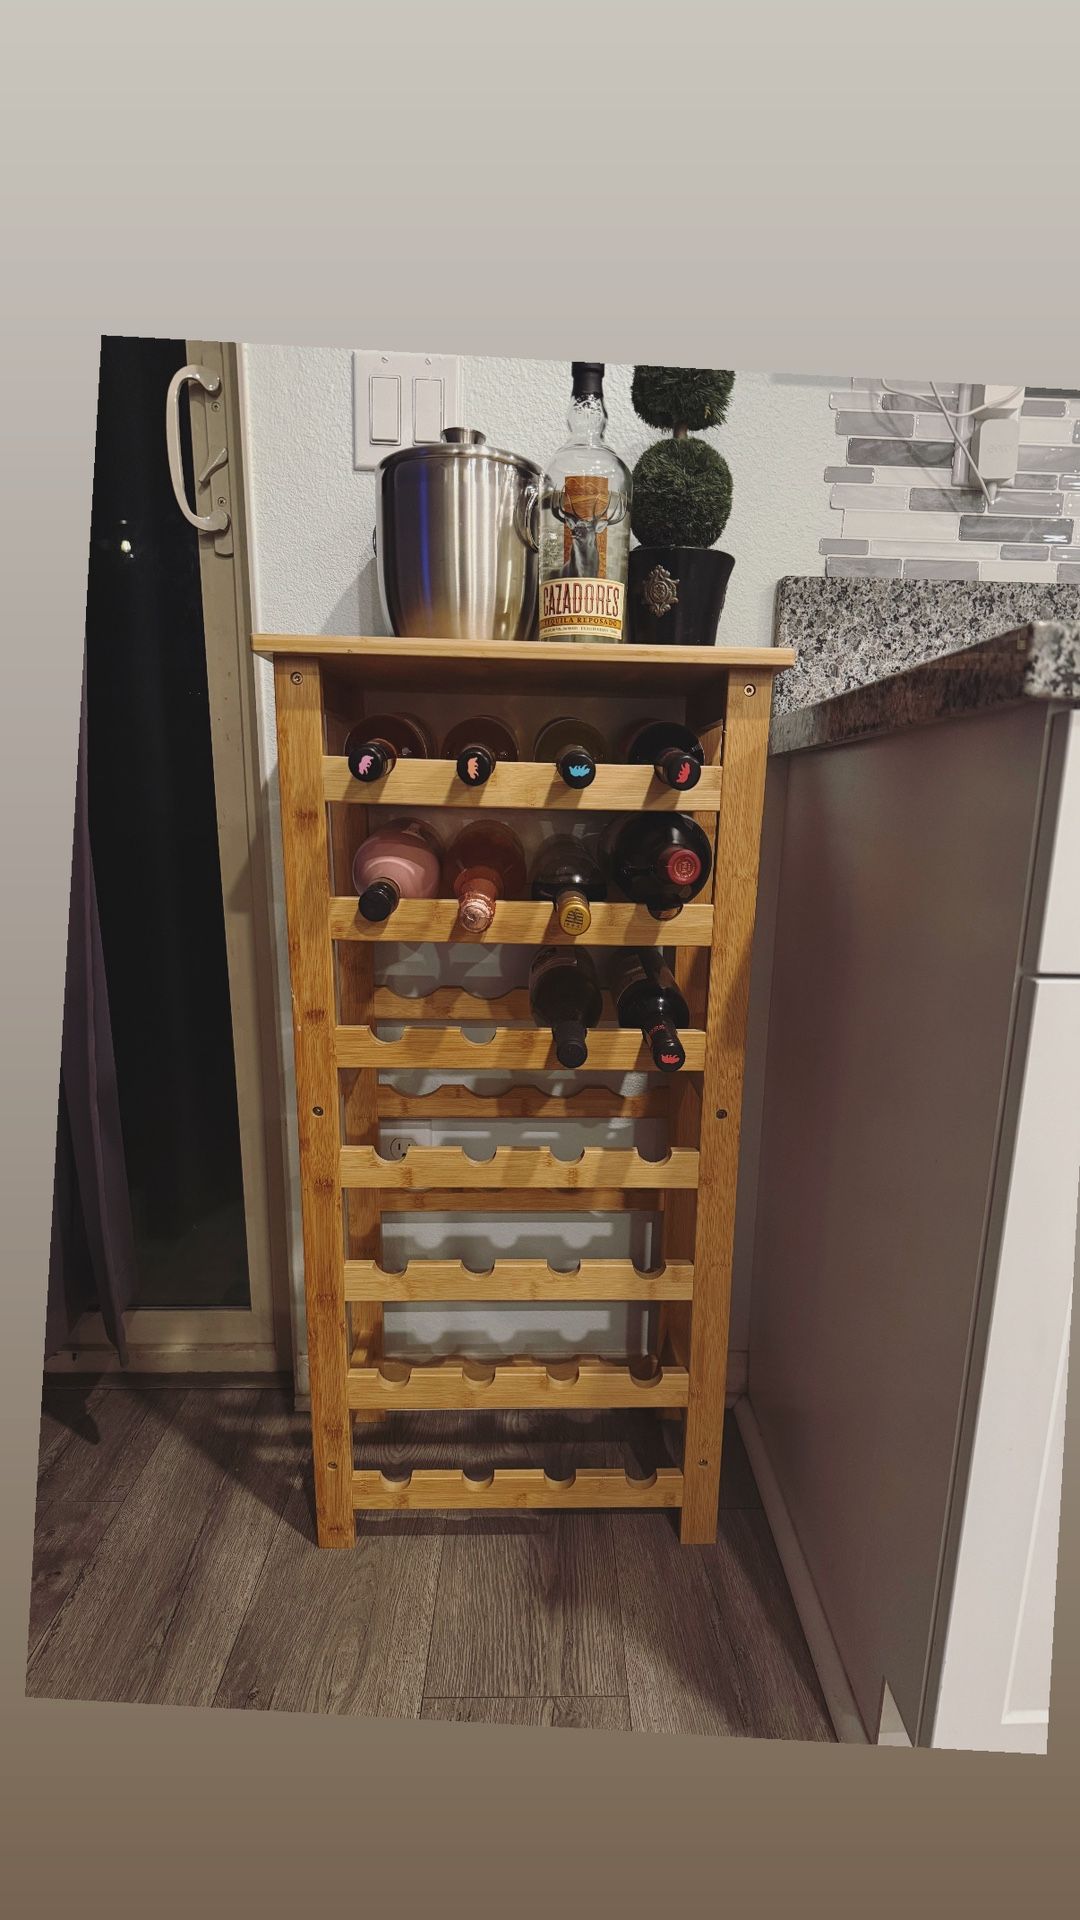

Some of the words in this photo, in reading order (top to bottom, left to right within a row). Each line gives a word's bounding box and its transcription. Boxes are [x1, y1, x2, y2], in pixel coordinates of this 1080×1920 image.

[543, 583, 620, 617] CAZADORES
[544, 617, 574, 626] TEQUILA
[576, 617, 617, 627] REPOSADO
